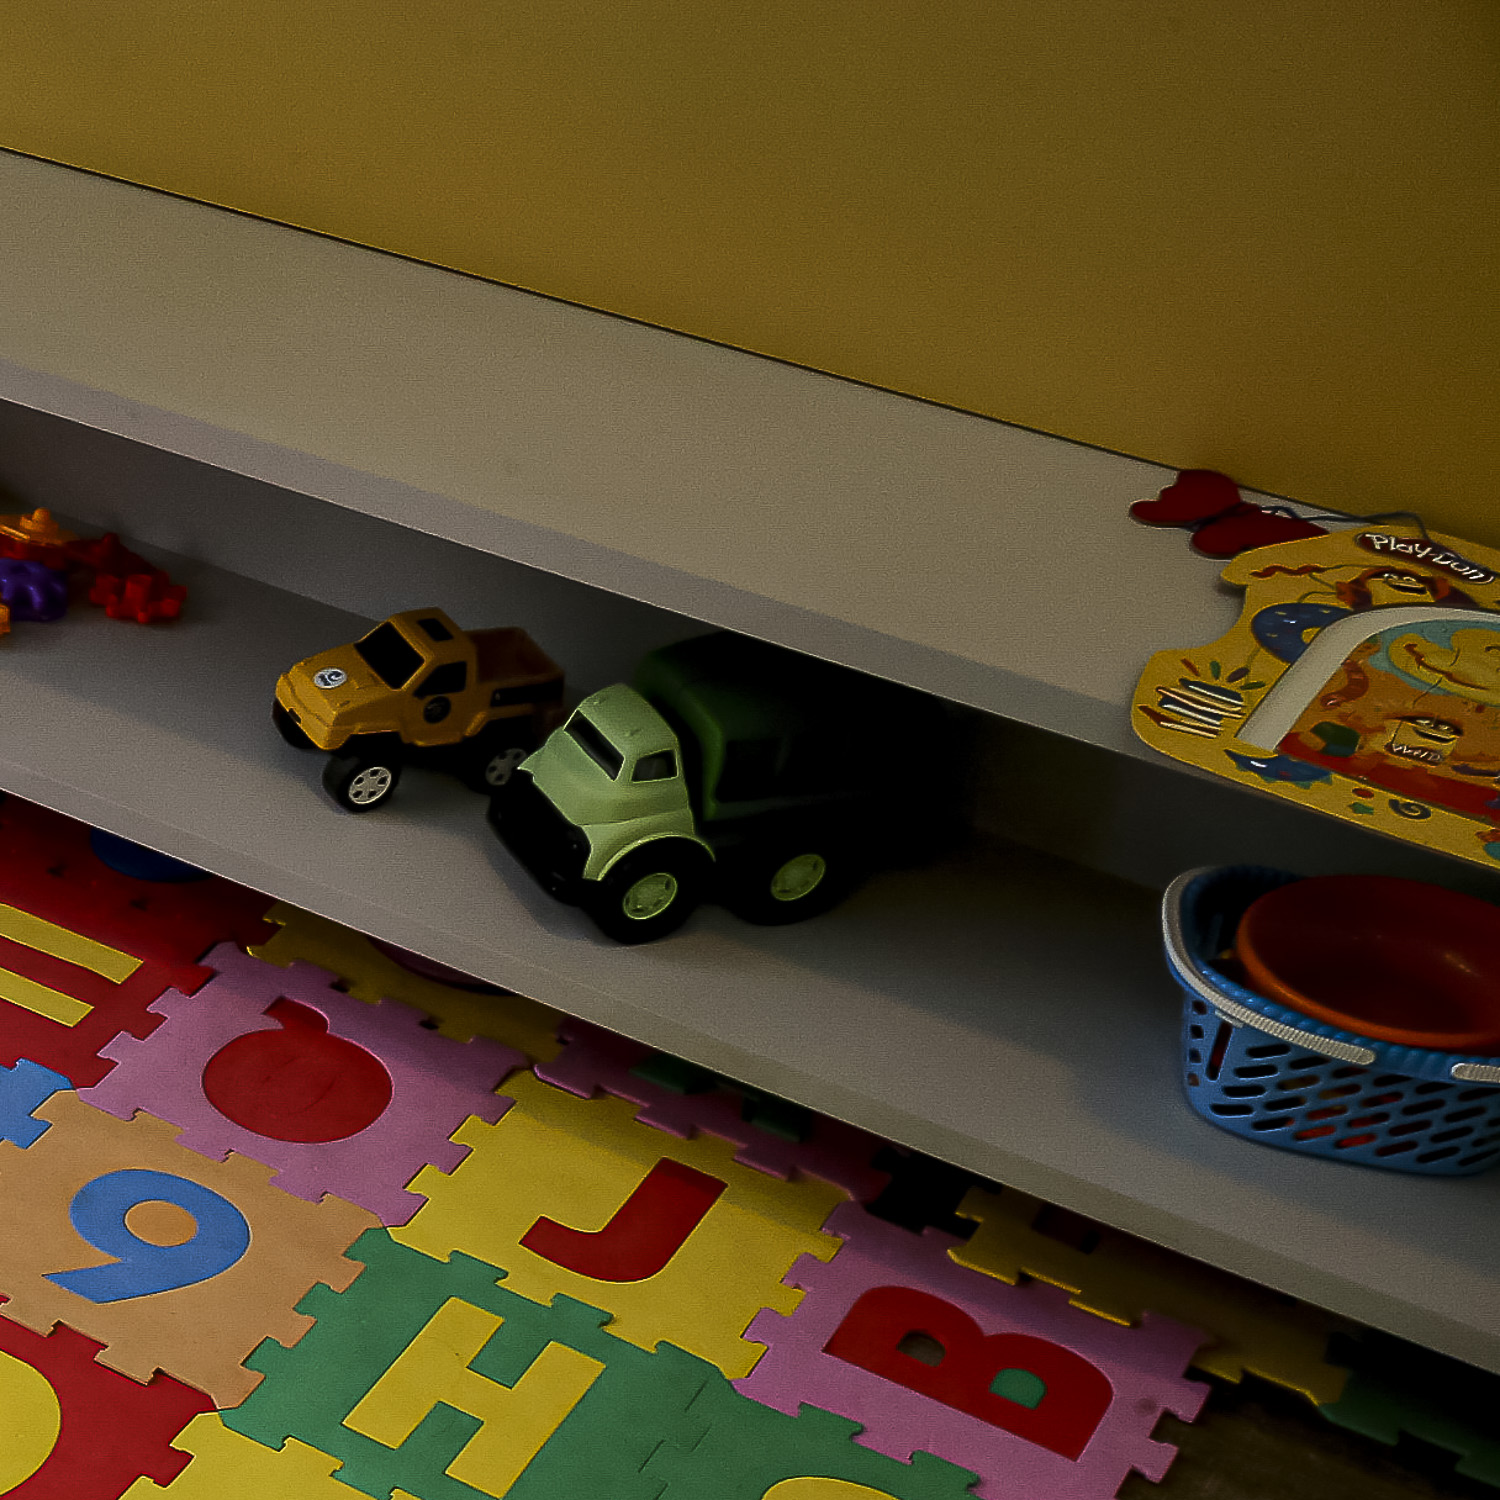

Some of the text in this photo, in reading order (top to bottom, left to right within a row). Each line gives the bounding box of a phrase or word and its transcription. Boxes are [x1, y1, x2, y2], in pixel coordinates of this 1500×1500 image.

[518, 1157, 728, 1283] J
[341, 1296, 606, 1499] H
[822, 1285, 1115, 1461] B
